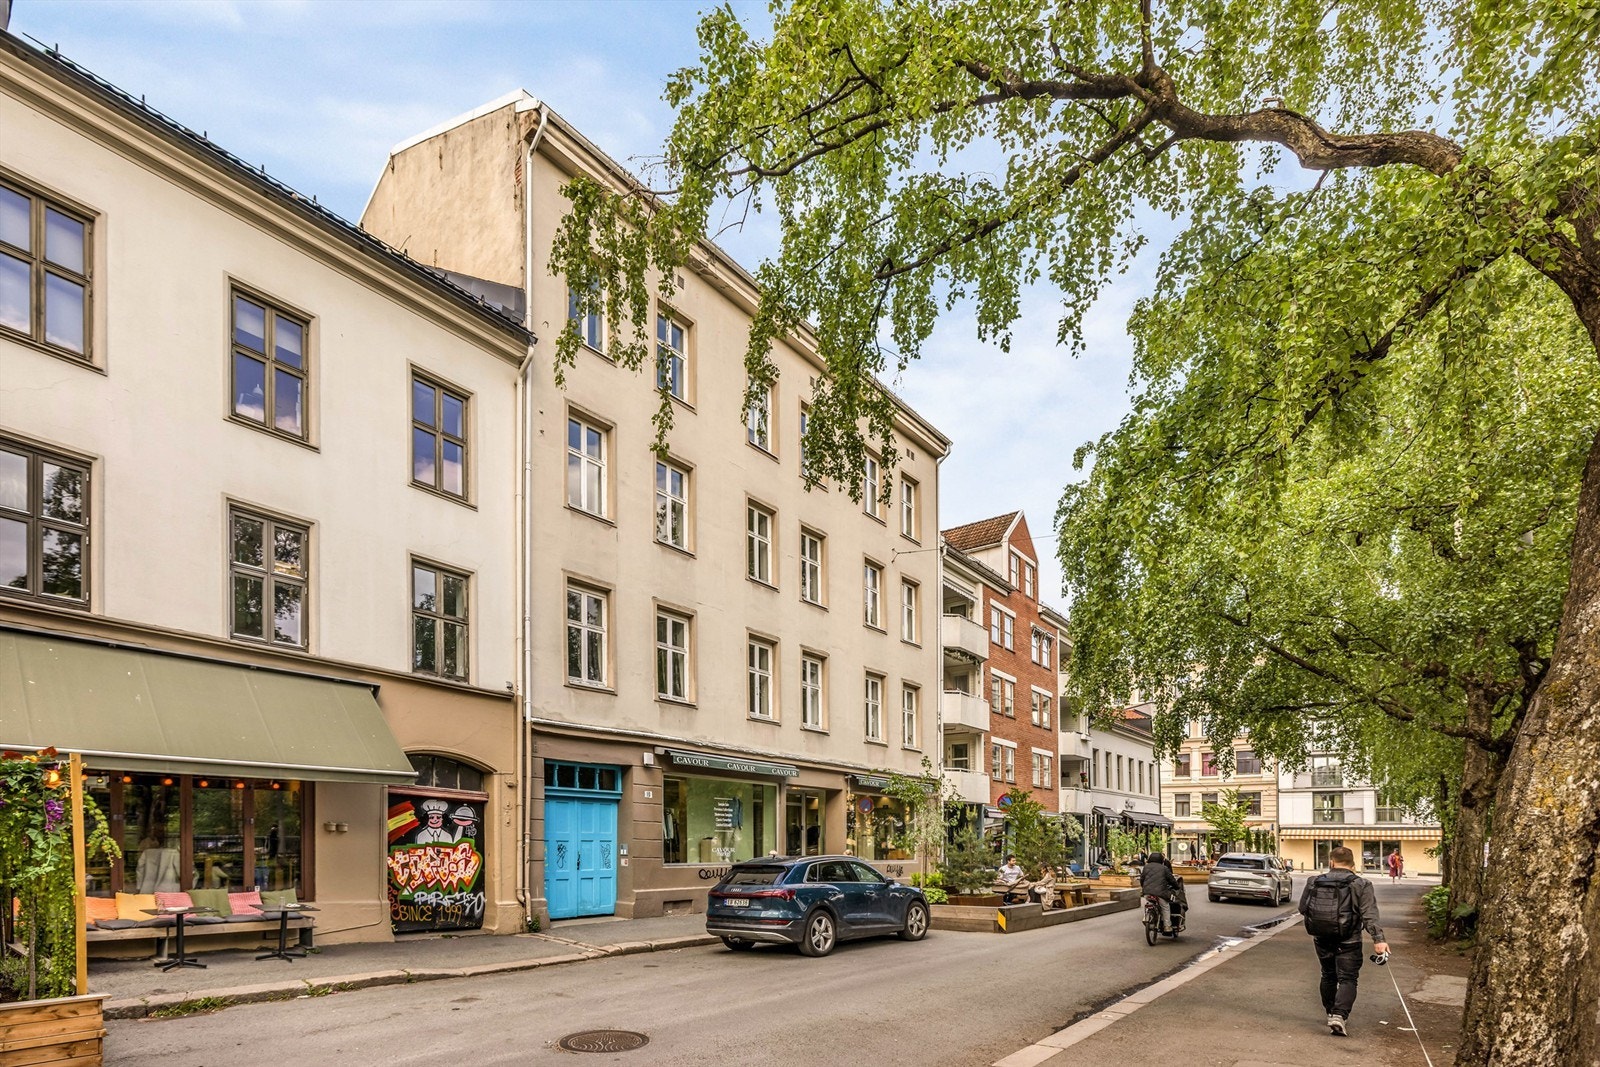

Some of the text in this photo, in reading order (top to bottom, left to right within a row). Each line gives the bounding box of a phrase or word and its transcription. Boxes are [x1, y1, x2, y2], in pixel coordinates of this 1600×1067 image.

[676, 756, 709, 767] CAVOUR
[727, 762, 756, 772] CAVOUR
[771, 768, 798, 777] CAVOUR
[400, 905, 432, 922] SINCE
